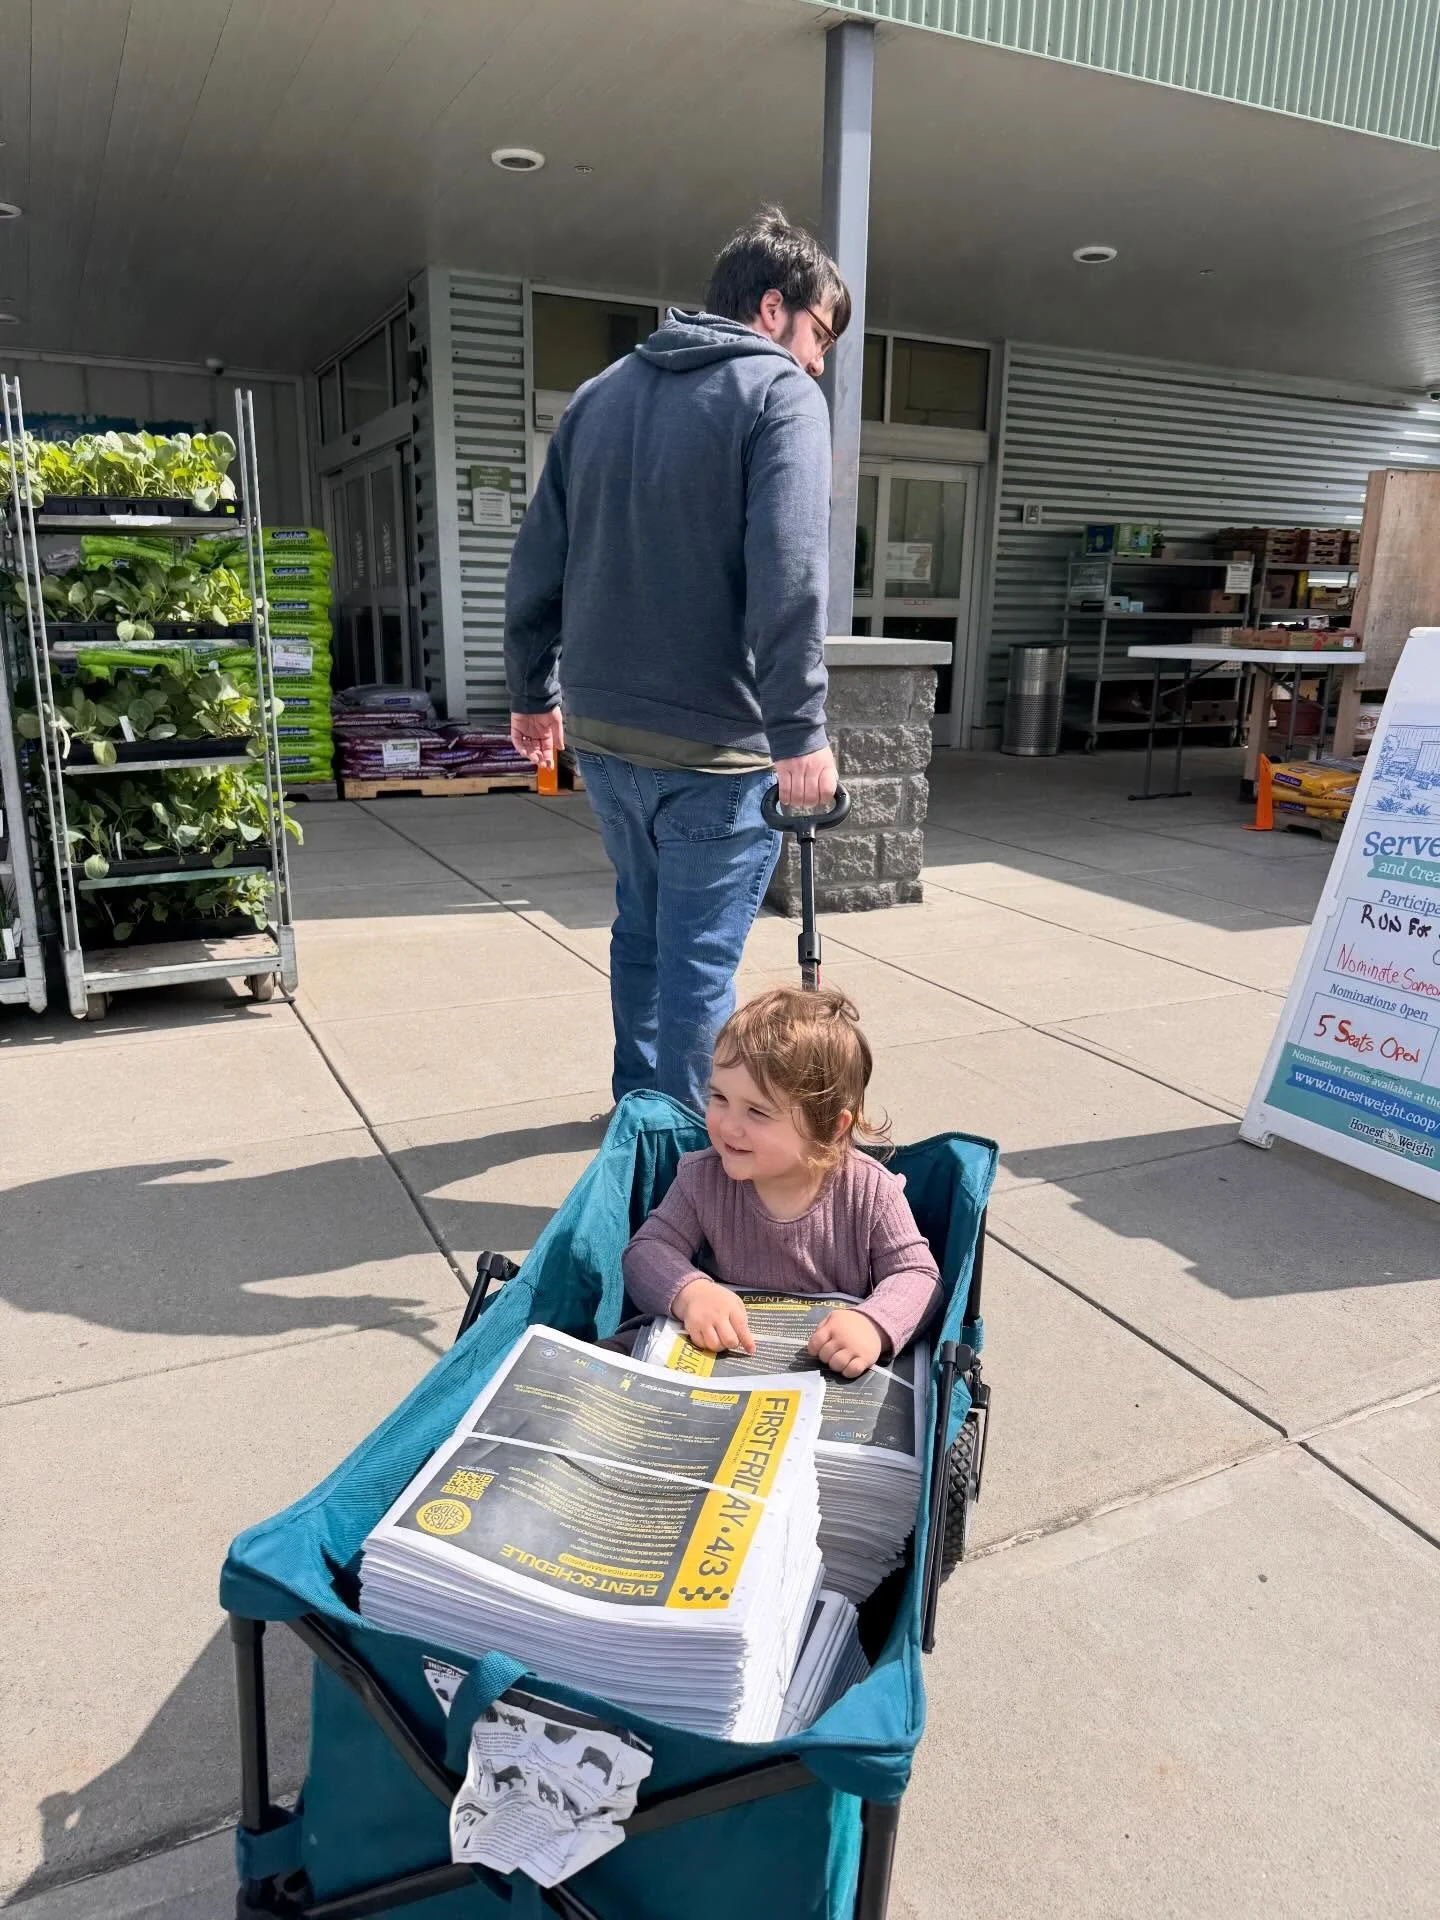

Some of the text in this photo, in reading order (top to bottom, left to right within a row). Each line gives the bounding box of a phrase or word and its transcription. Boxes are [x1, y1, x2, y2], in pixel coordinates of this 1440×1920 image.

[1363, 831, 1440, 857] Serve
[1378, 862, 1408, 876] and
[1361, 903, 1402, 933] RUN
[1337, 942, 1440, 997] Nominate Someo
[1329, 983, 1429, 1021] Nominations Open
[1313, 1014, 1336, 1037] 5
[1334, 1019, 1374, 1053] Seats
[1292, 1048, 1341, 1073] Nomination
[1343, 1066, 1371, 1083] Forms
[1372, 1077, 1413, 1098] available
[1413, 1091, 1425, 1101] at
[1350, 1117, 1385, 1139] Honest
[1399, 1134, 1435, 1158] Weight
[750, 1397, 790, 1450] FIRST
[500, 1543, 597, 1588] SCHEDULE
[698, 1536, 735, 1577] 4/3
[594, 1579, 659, 1597] EVENT
